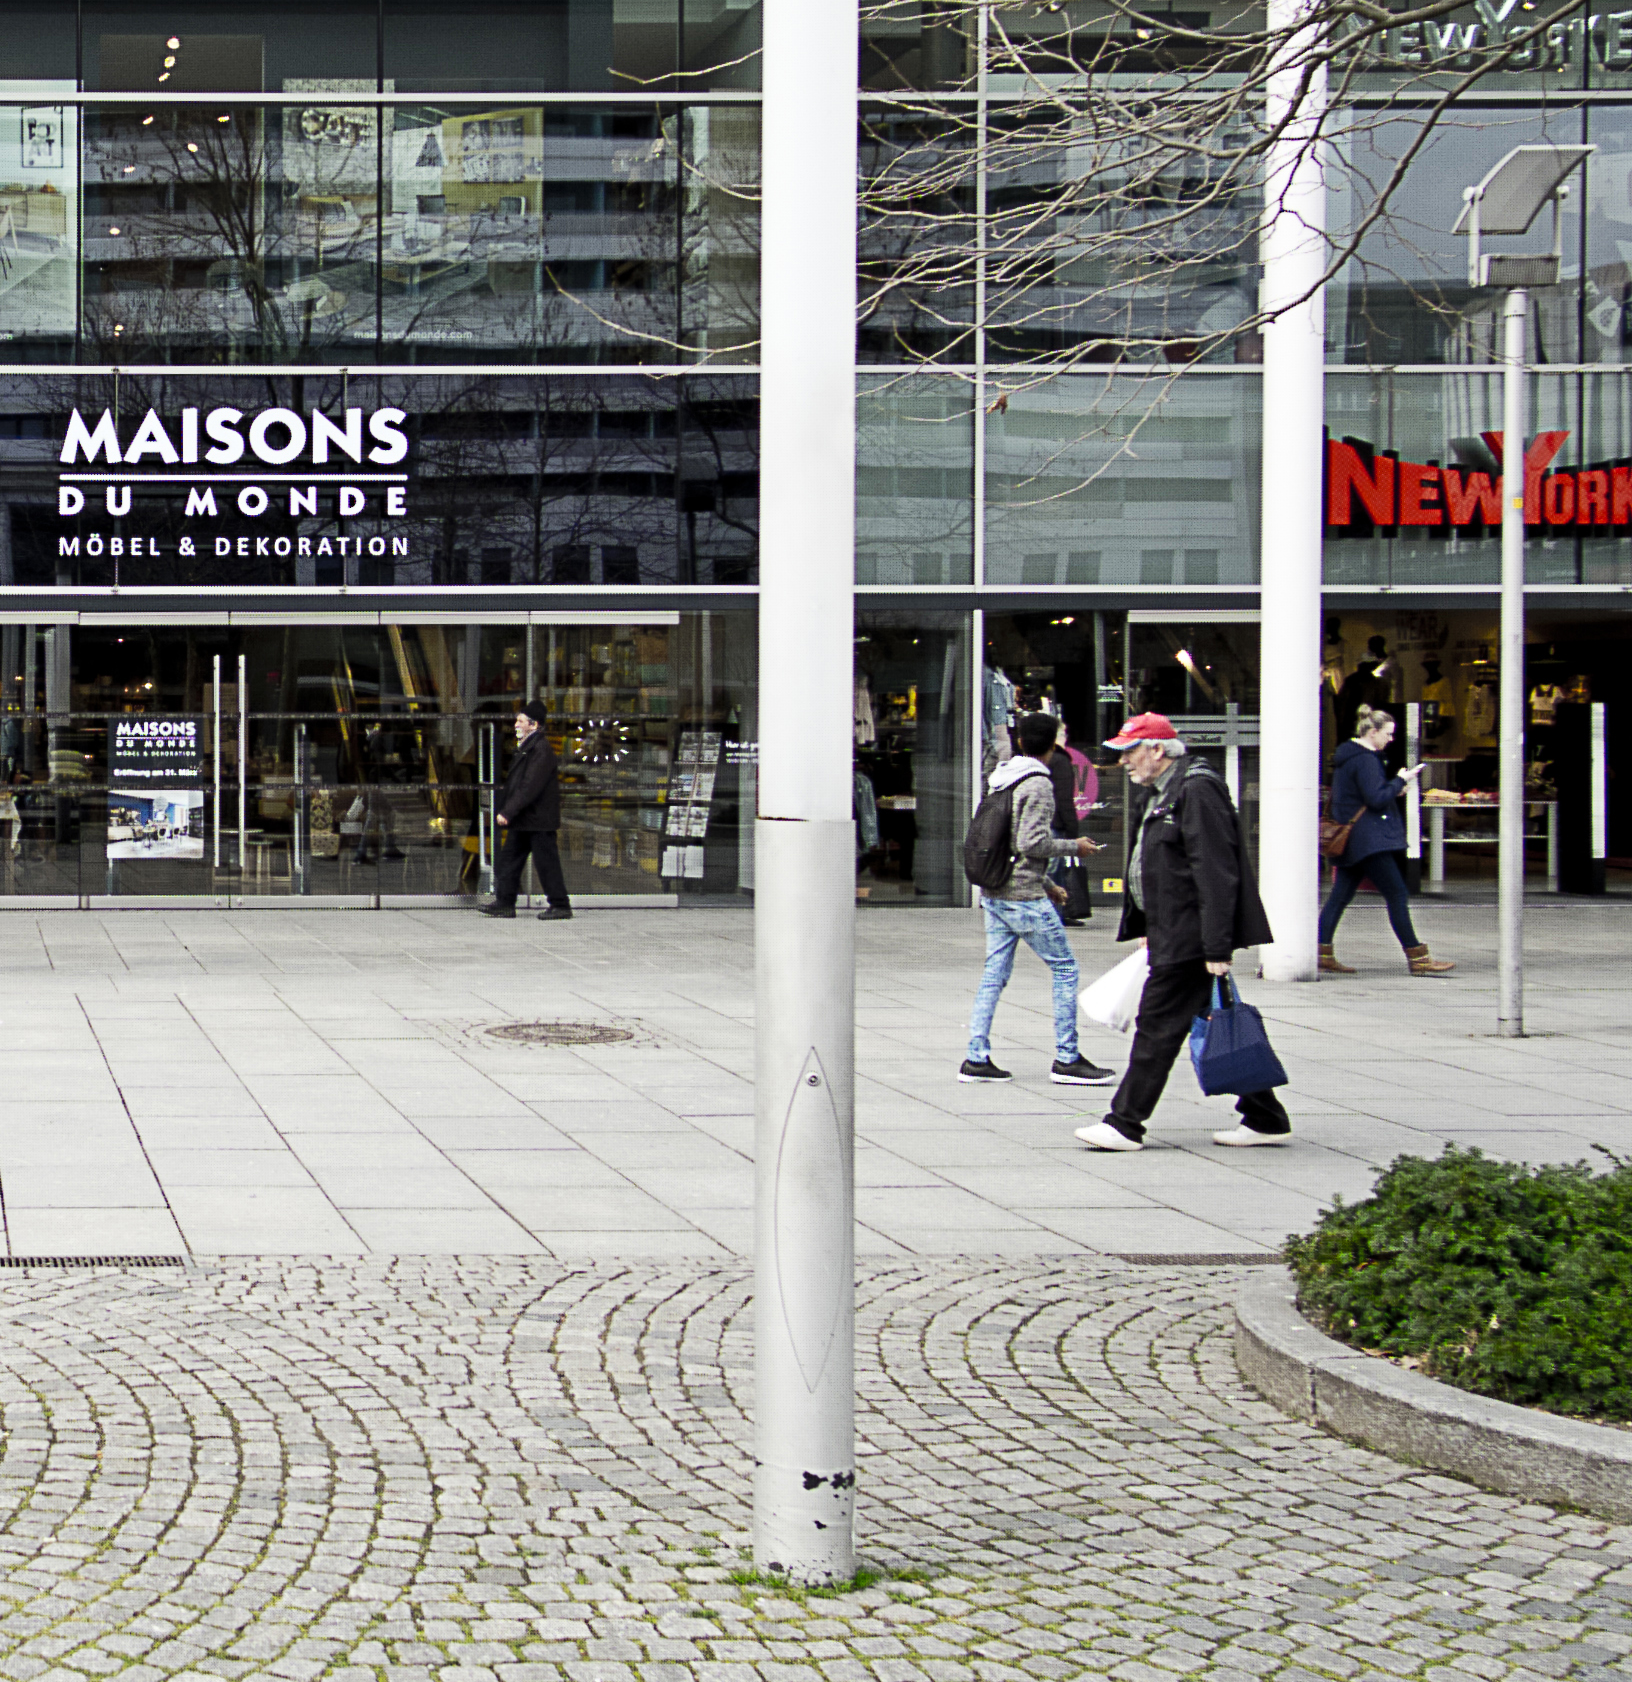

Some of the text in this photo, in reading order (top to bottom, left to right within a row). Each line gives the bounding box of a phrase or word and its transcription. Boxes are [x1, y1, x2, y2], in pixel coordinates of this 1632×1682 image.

[353, 330, 473, 340] maisnsdumonde.com
[59, 407, 408, 465] MAISONS
[59, 486, 407, 516] DU MONDE
[59, 533, 409, 557] MÖBEL & DEKORATION
[116, 721, 196, 736] MAISONS
[116, 739, 195, 748] DU MONDE
